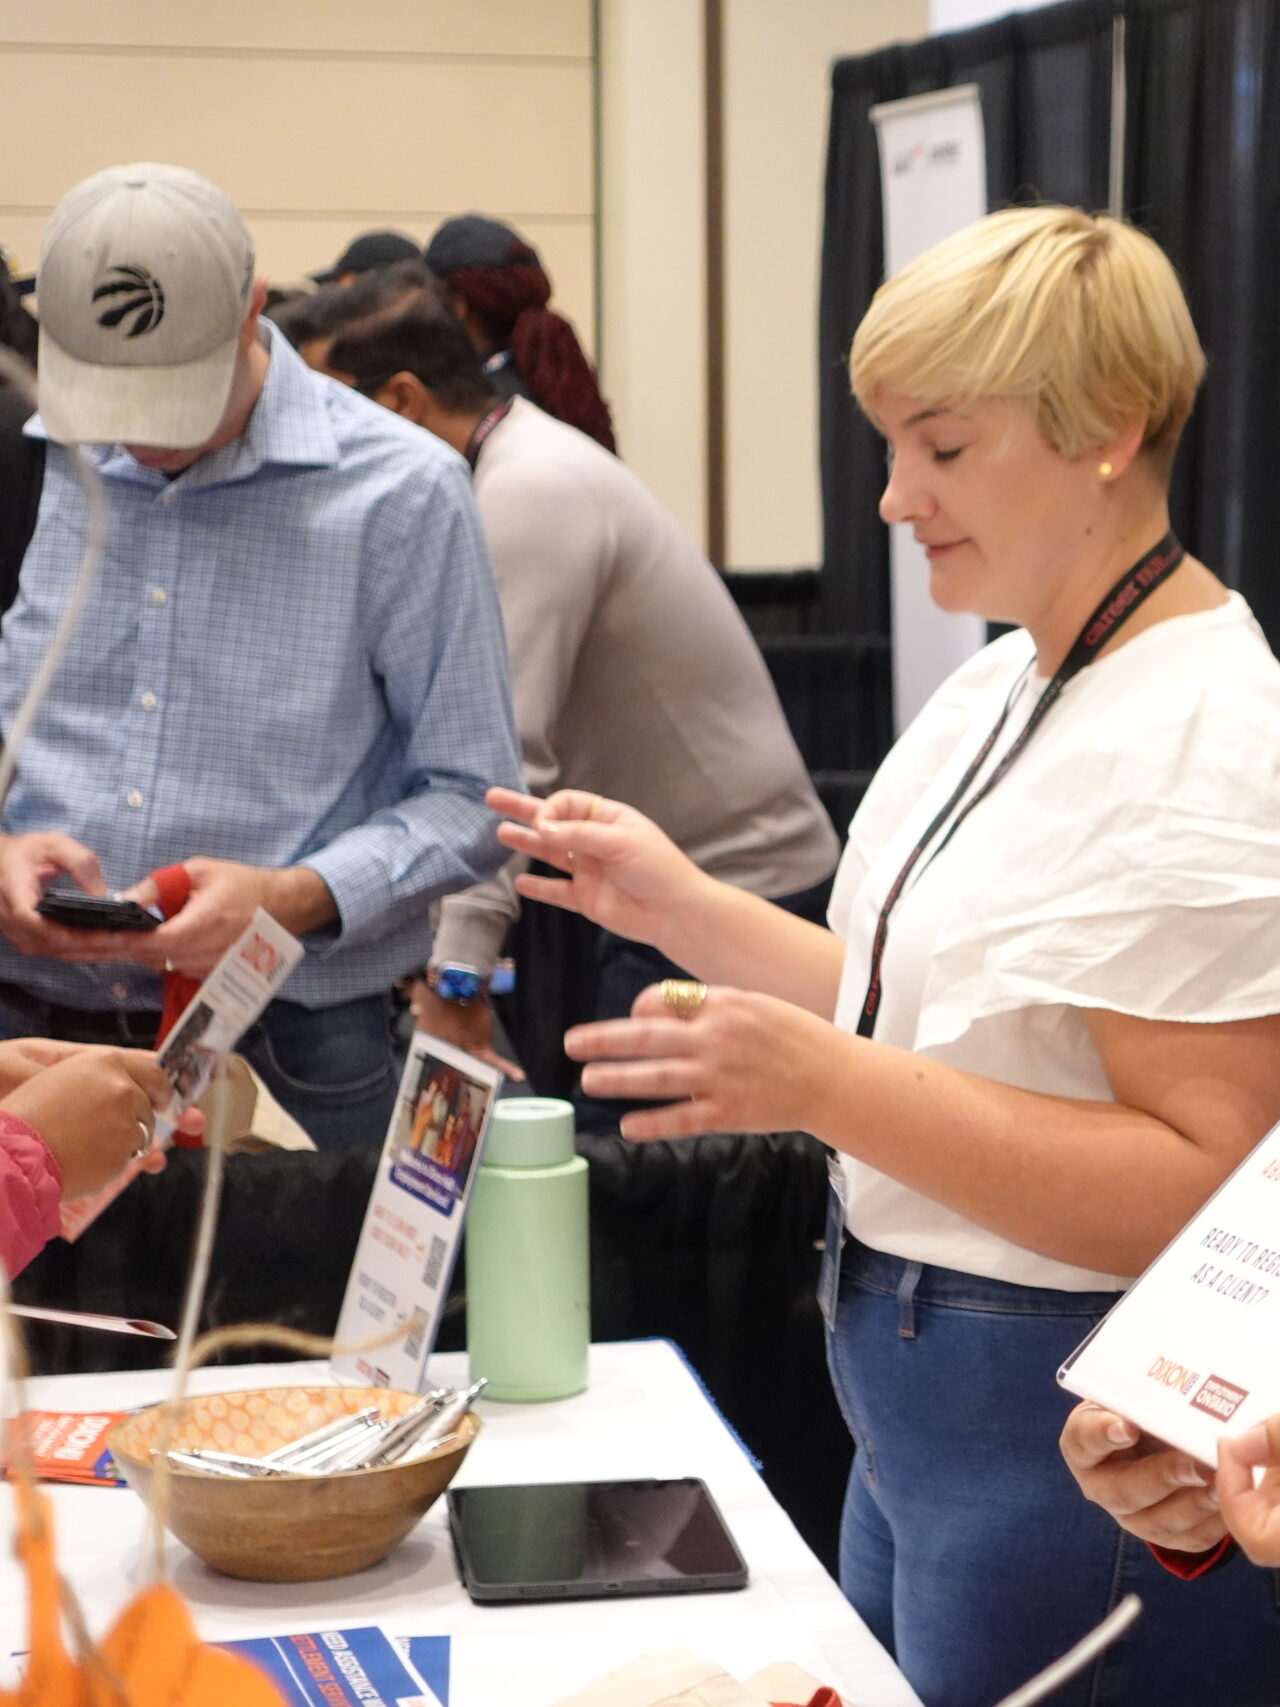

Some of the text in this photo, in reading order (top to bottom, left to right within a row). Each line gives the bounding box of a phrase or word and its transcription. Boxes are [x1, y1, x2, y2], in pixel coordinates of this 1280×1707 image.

[1199, 1227, 1245, 1257] READY
[1236, 1241, 1260, 1264] TO
[1190, 1262, 1270, 1308] AS A CLIENT?
[1146, 1356, 1189, 1393] DIXON
[1195, 1389, 1236, 1418] ONTARIO
